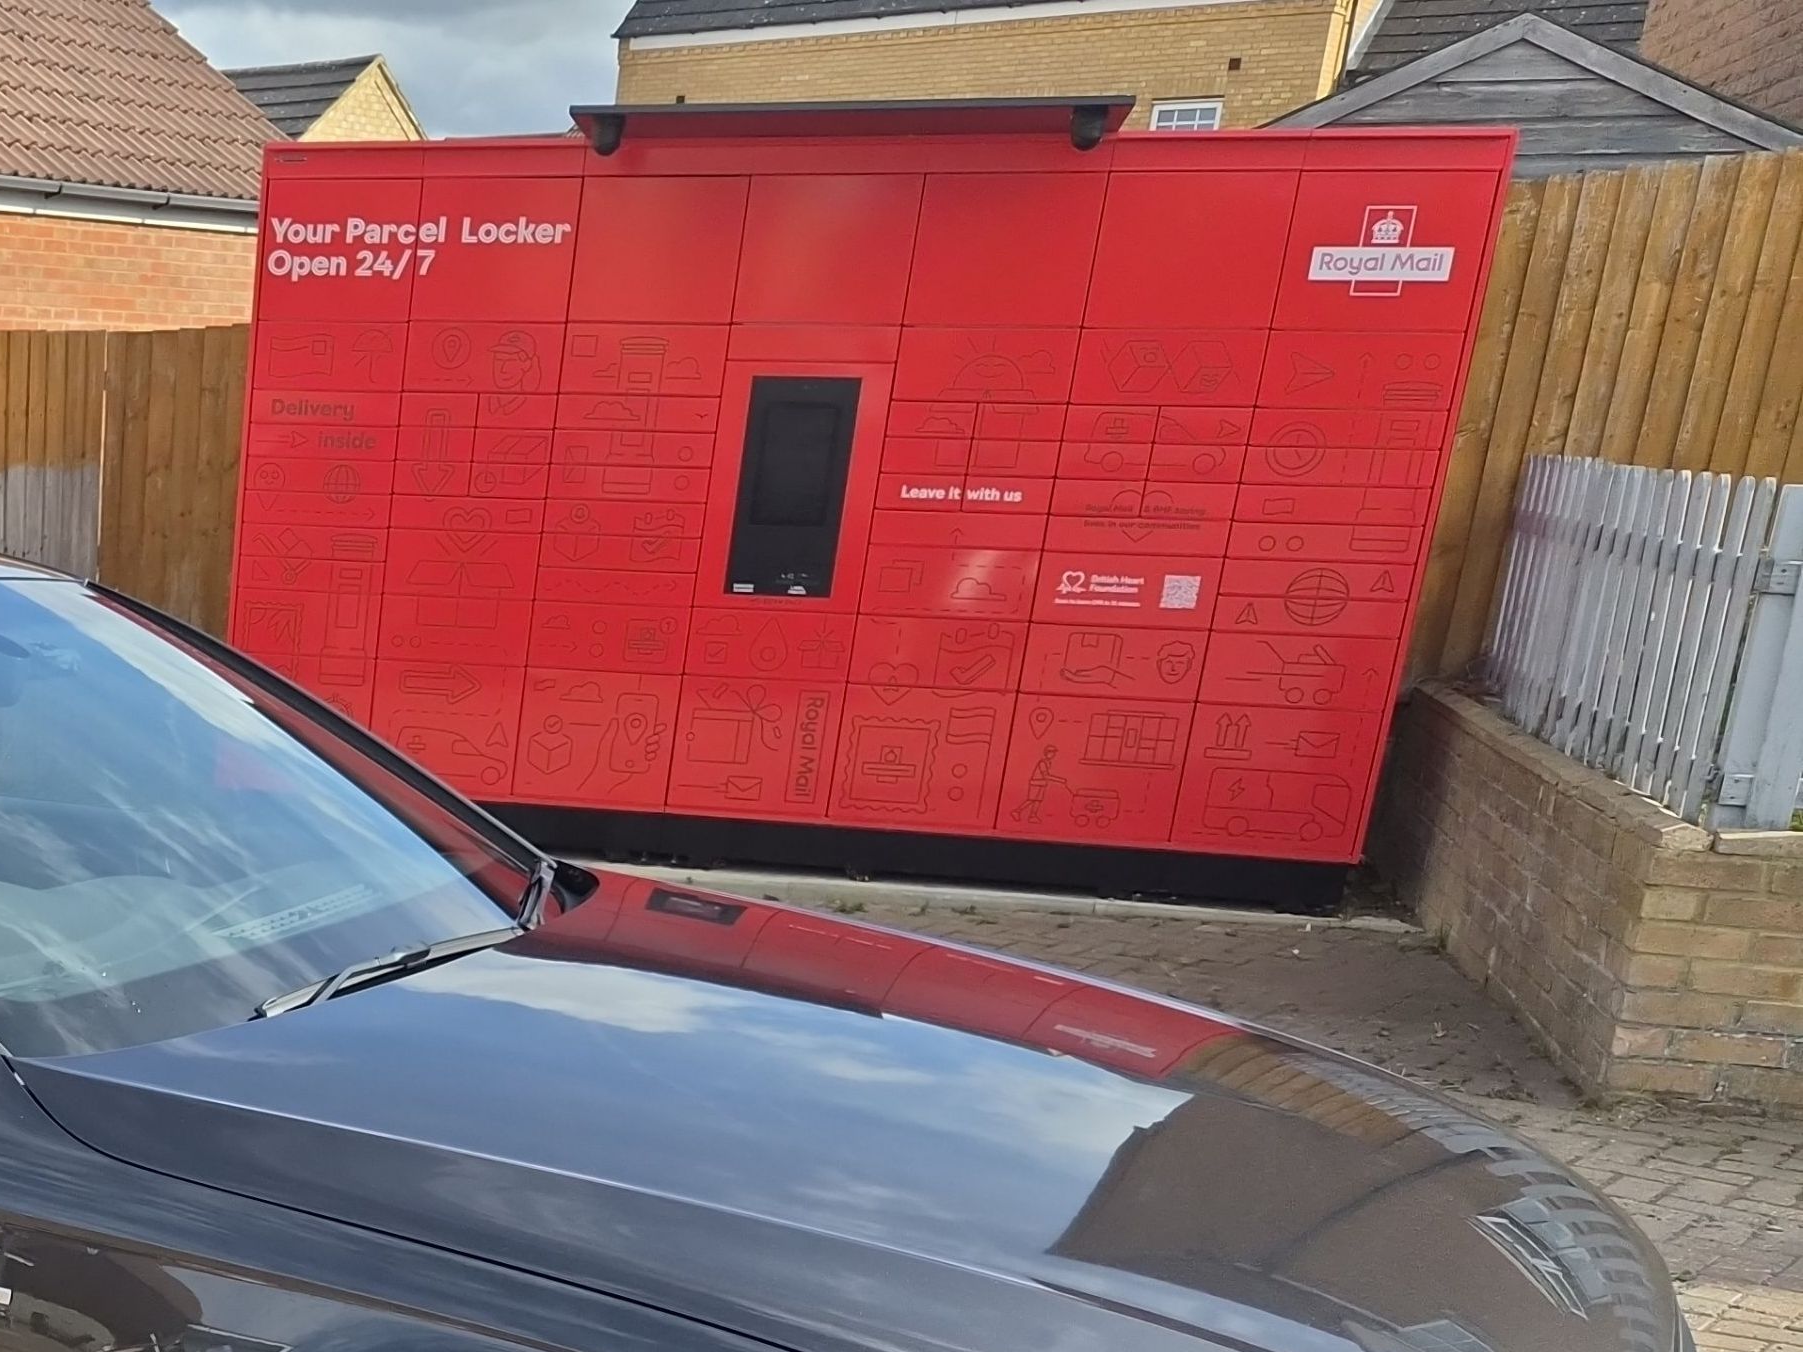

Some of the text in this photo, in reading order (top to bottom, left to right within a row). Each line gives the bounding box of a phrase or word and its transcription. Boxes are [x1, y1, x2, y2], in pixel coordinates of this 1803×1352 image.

[270, 216, 571, 244] Your Parcel Locker
[267, 249, 436, 282] Open 24/7
[1318, 252, 1445, 276] Royal Mail
[271, 398, 355, 421] Delivery
[318, 431, 377, 450] inside
[900, 484, 946, 500] Leave
[966, 487, 1000, 501] with
[1003, 490, 1023, 502] us
[794, 696, 825, 796] Royal Mail
